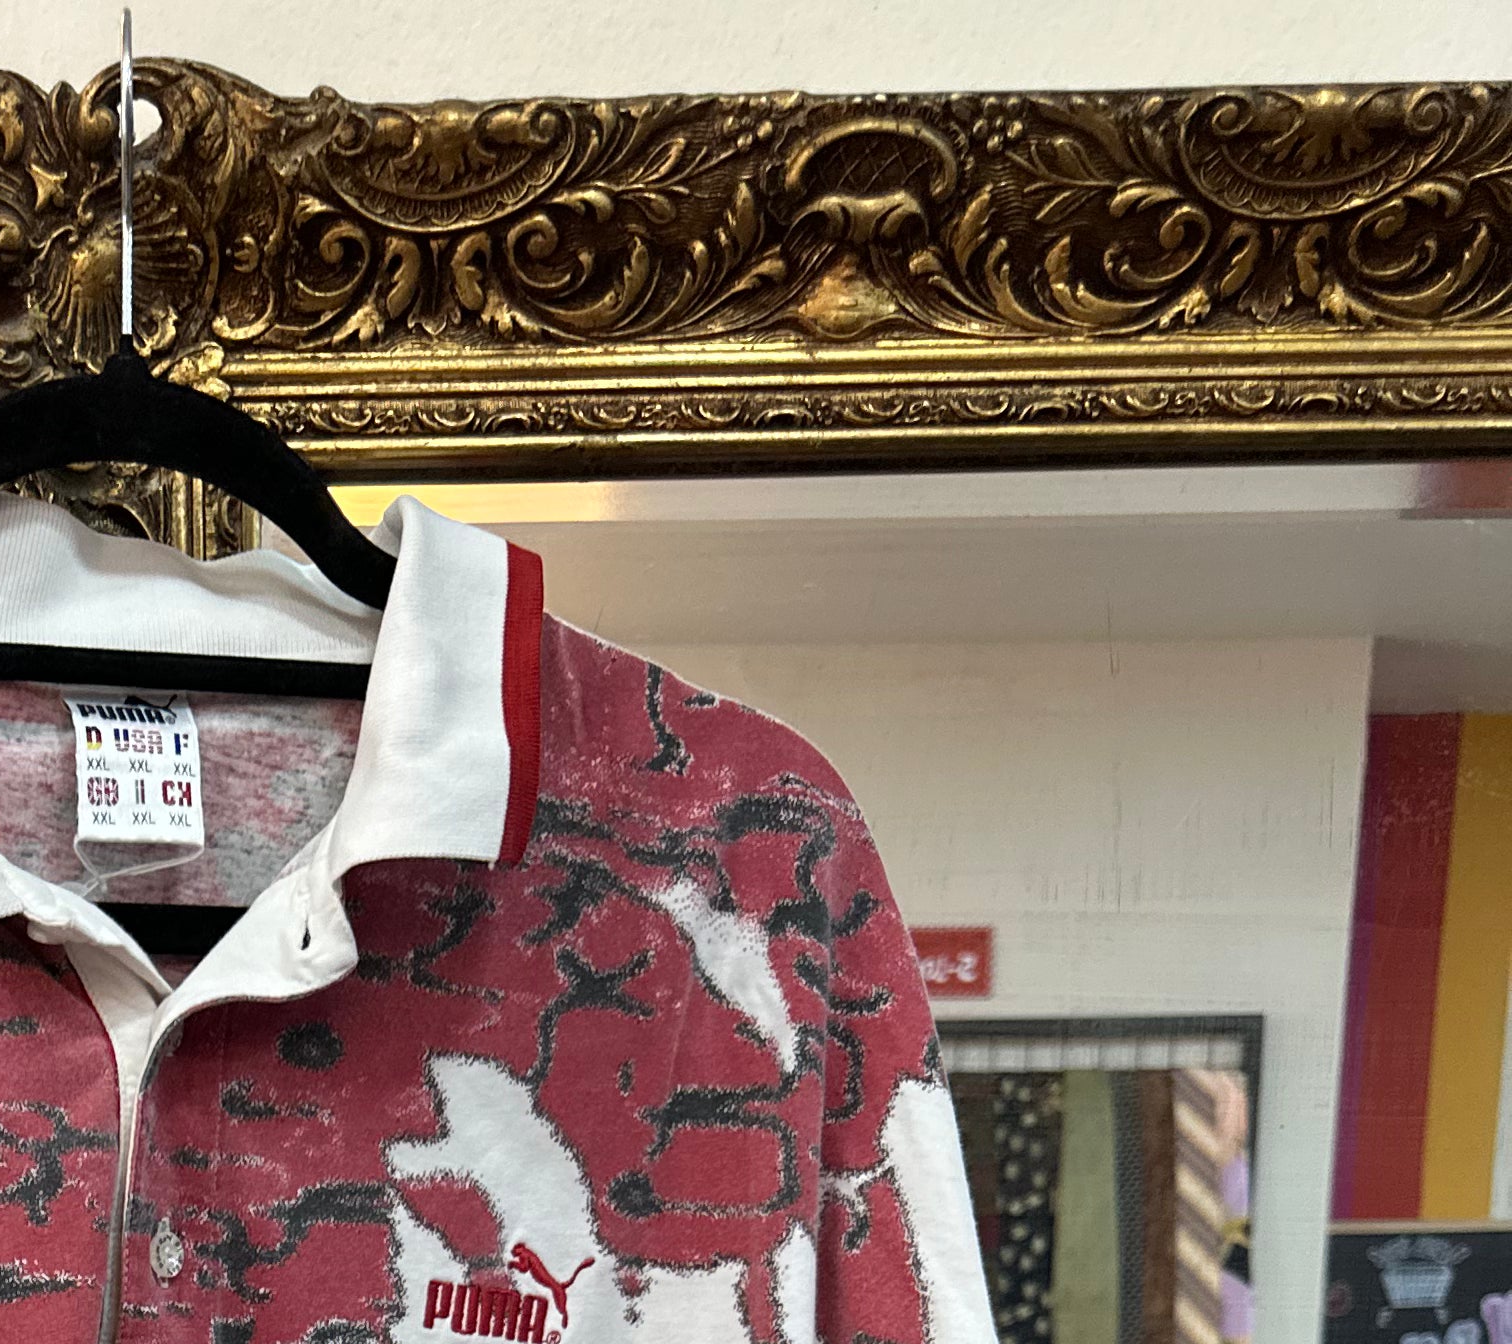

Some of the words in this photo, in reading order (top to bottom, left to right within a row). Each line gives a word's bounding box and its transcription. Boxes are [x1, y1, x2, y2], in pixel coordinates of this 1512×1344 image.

[76, 703, 166, 724] PUMA
[85, 726, 103, 750] D
[113, 728, 164, 755] USA
[87, 756, 110, 772] XXL
[128, 758, 153, 773] XXL
[173, 762, 196, 777] XXL
[87, 776, 120, 807] GB
[161, 780, 193, 807] CH
[92, 811, 116, 826] XXL
[132, 812, 156, 826] XXL
[169, 813, 192, 828] XXL
[422, 1279, 550, 1344] PUMA
